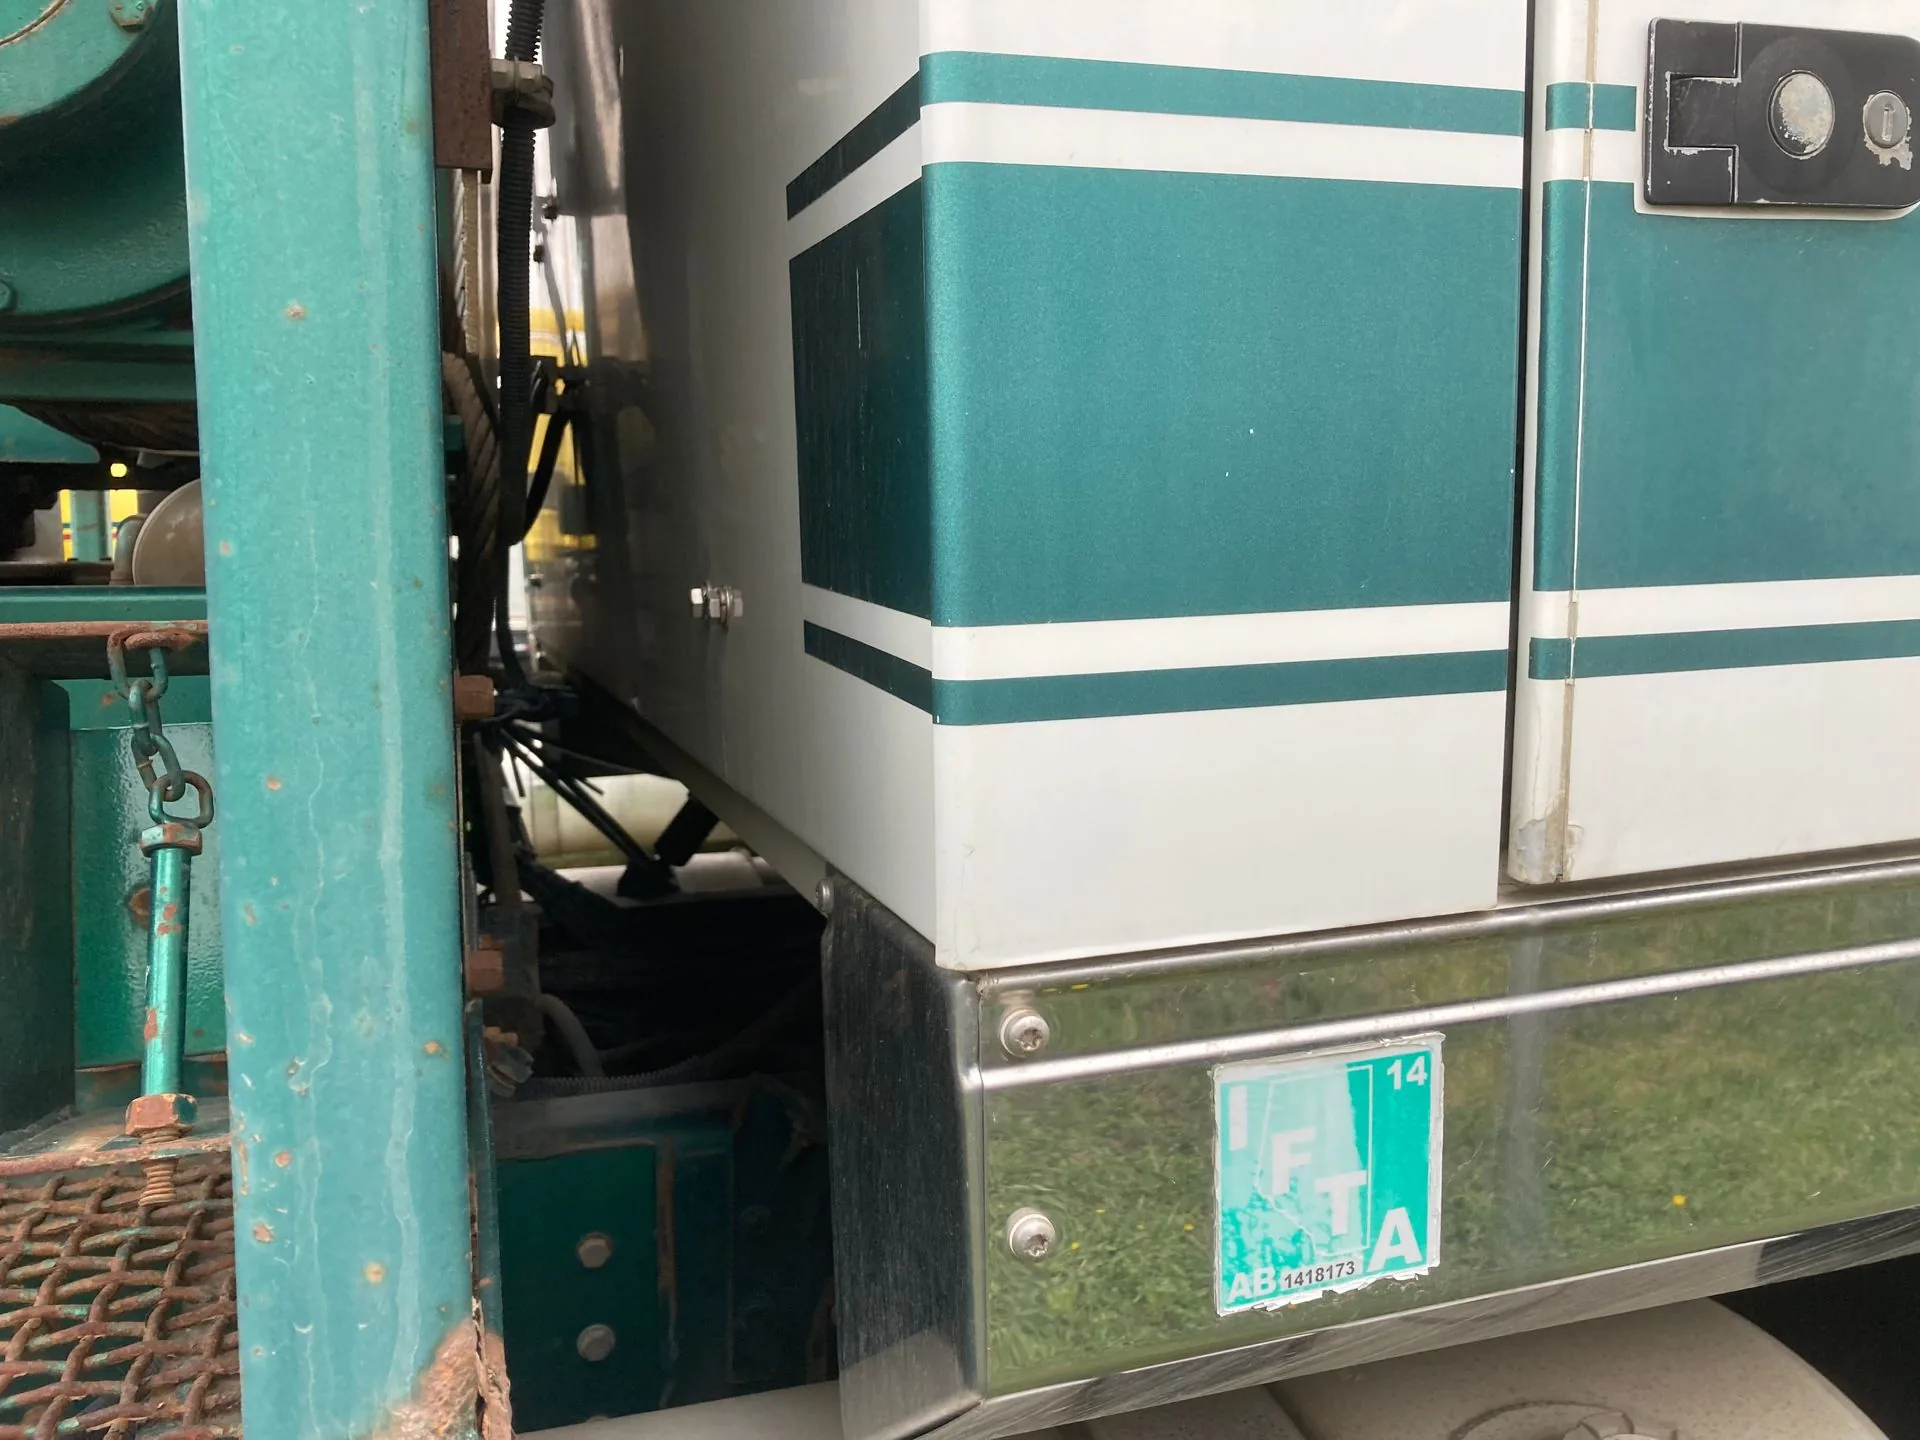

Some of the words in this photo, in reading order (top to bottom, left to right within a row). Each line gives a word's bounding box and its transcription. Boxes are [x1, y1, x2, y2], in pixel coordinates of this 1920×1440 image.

[1387, 1055, 1428, 1090] 14
[1228, 1266, 1277, 1302] AB
[1283, 1260, 1356, 1289] 1418173
